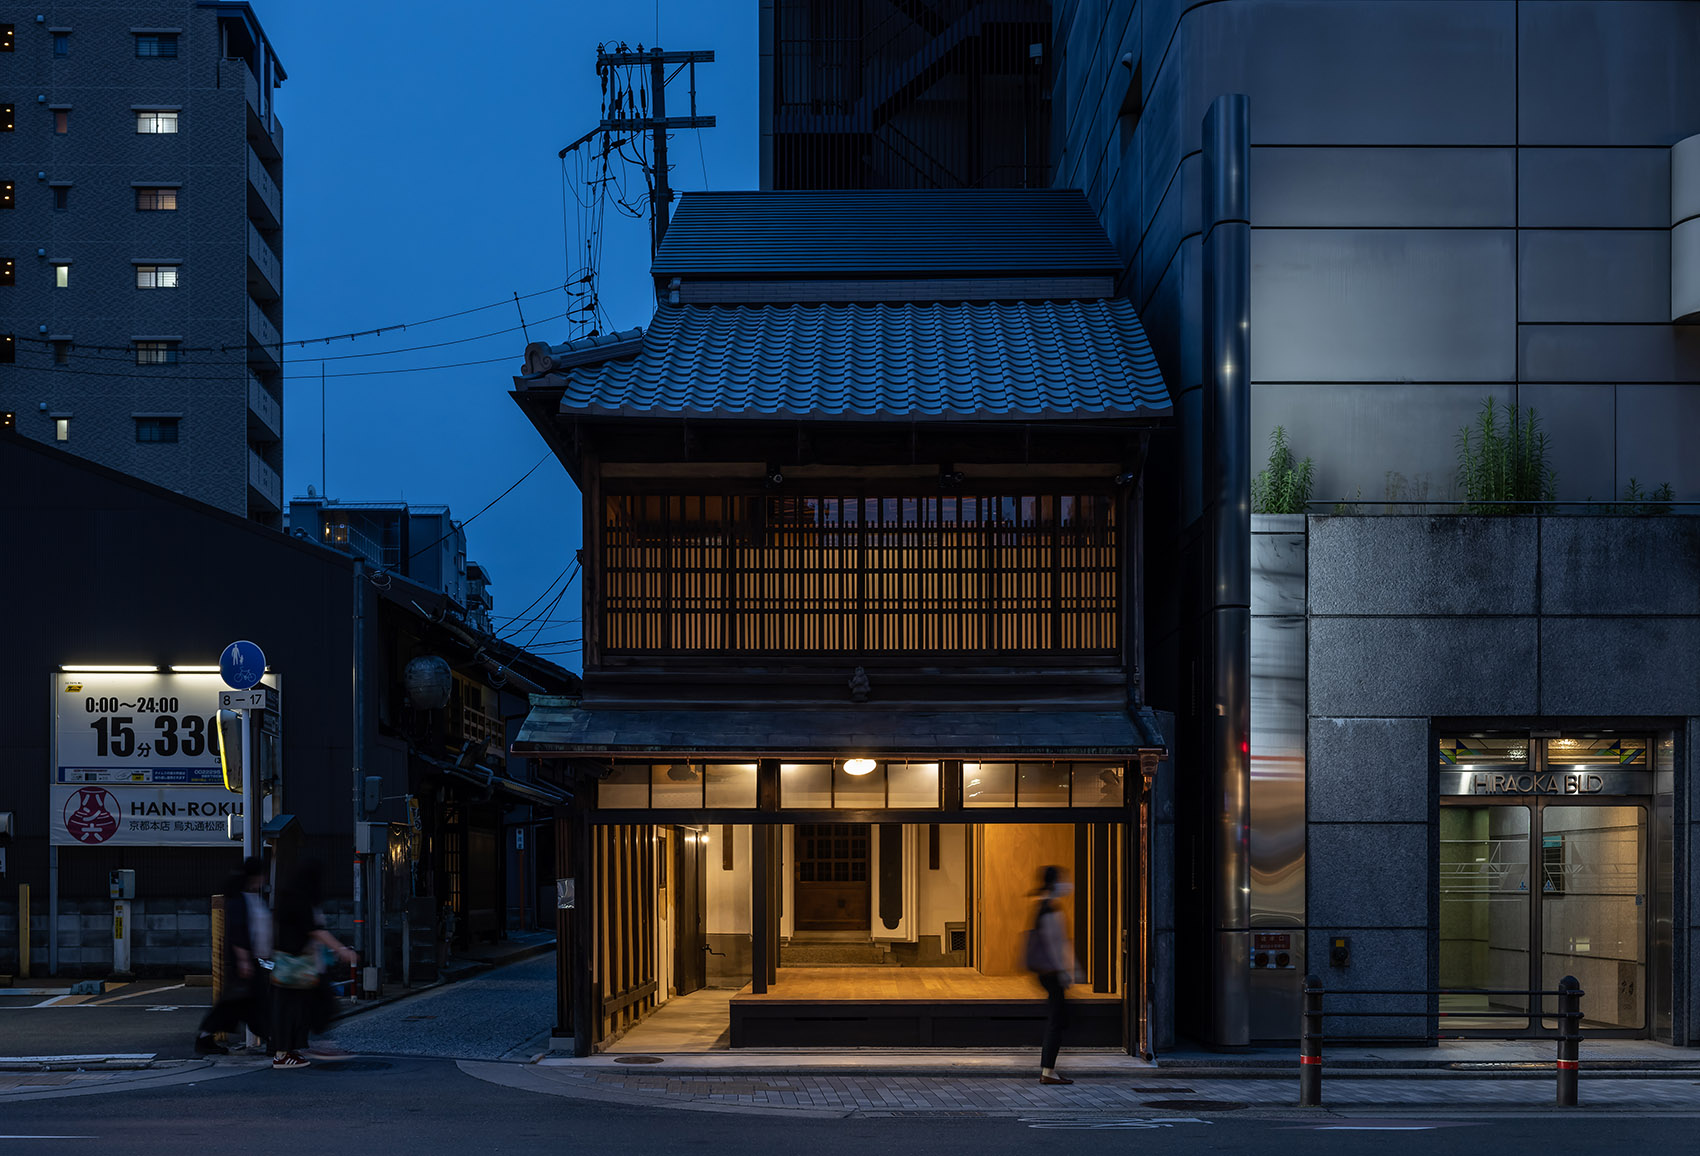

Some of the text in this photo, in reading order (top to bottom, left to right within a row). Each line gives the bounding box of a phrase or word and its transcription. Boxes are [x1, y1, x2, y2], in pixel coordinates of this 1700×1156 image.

[1474, 774, 1604, 794] HIRAOKA BLD
[131, 801, 243, 816] HAN-ROKU
[129, 820, 229, 832] 京都本店 烏丸通松原
